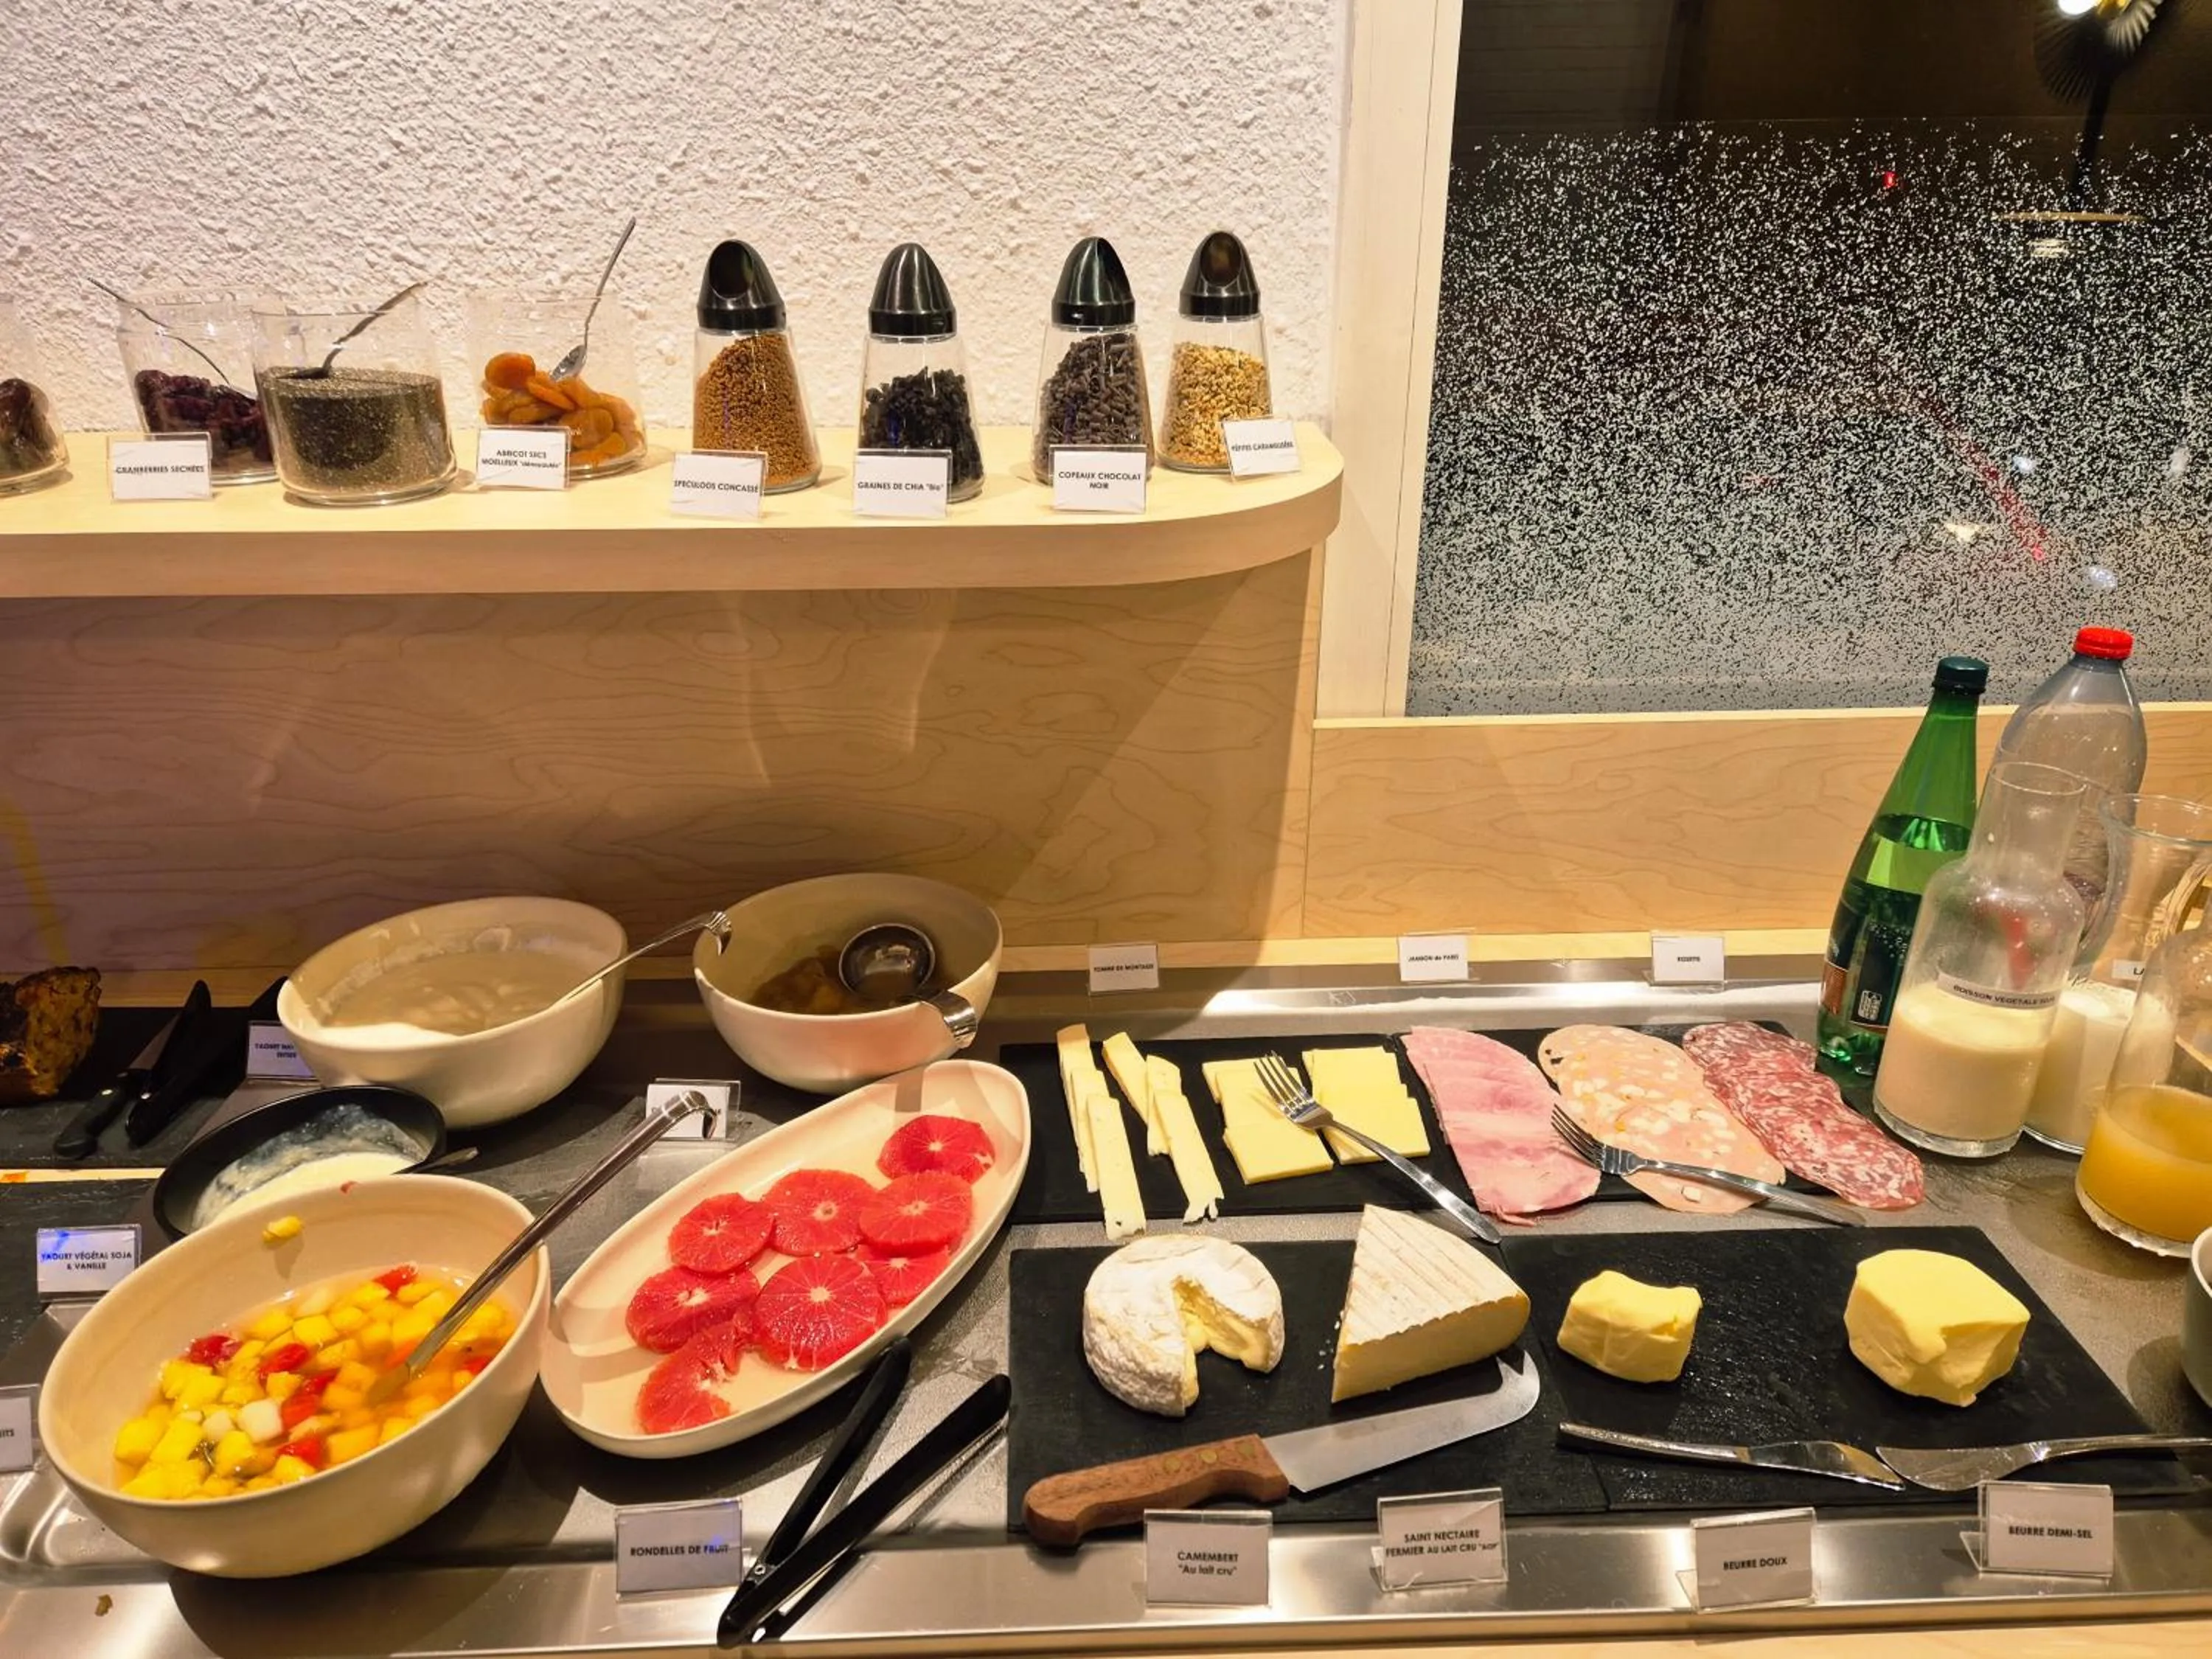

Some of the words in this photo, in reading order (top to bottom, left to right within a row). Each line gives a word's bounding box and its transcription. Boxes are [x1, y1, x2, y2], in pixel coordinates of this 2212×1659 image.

[496, 450, 527, 458] ABRICOT
[529, 451, 547, 459] SECS
[116, 466, 169, 474] CRANBERRIES
[1058, 472, 1096, 480] COPEAUX
[1098, 473, 1141, 481] CHOCOLAT
[674, 480, 716, 490] SPECULOOS
[858, 481, 891, 490] GRAINES
[893, 482, 903, 490] DE
[41, 1252, 72, 1261] YAOURT
[74, 1251, 108, 1260] VÉGÉTAL
[111, 1251, 132, 1259] SOJA
[74, 1262, 106, 1270] VANILLE
[1404, 1531, 1432, 1543] SAINT
[1434, 1529, 1480, 1542] NECTAIRE
[2008, 1526, 2045, 1536] BEURRE
[2047, 1527, 2093, 1539] DEMI-SEL
[630, 1545, 685, 1557] RONDELLES
[688, 1545, 701, 1554] DE
[1385, 1545, 1424, 1557] FERMIER
[1427, 1545, 1439, 1554] AU
[1440, 1545, 1458, 1554] LAIT
[1459, 1543, 1477, 1552] CRU
[1178, 1551, 1239, 1562] CAMEMBERT
[1723, 1559, 1757, 1571] BEURRE
[1759, 1557, 1787, 1568] DOUX
[1178, 1564, 1197, 1574] "Au
[1199, 1564, 1215, 1575] lait
[1217, 1565, 1238, 1576] cru"
